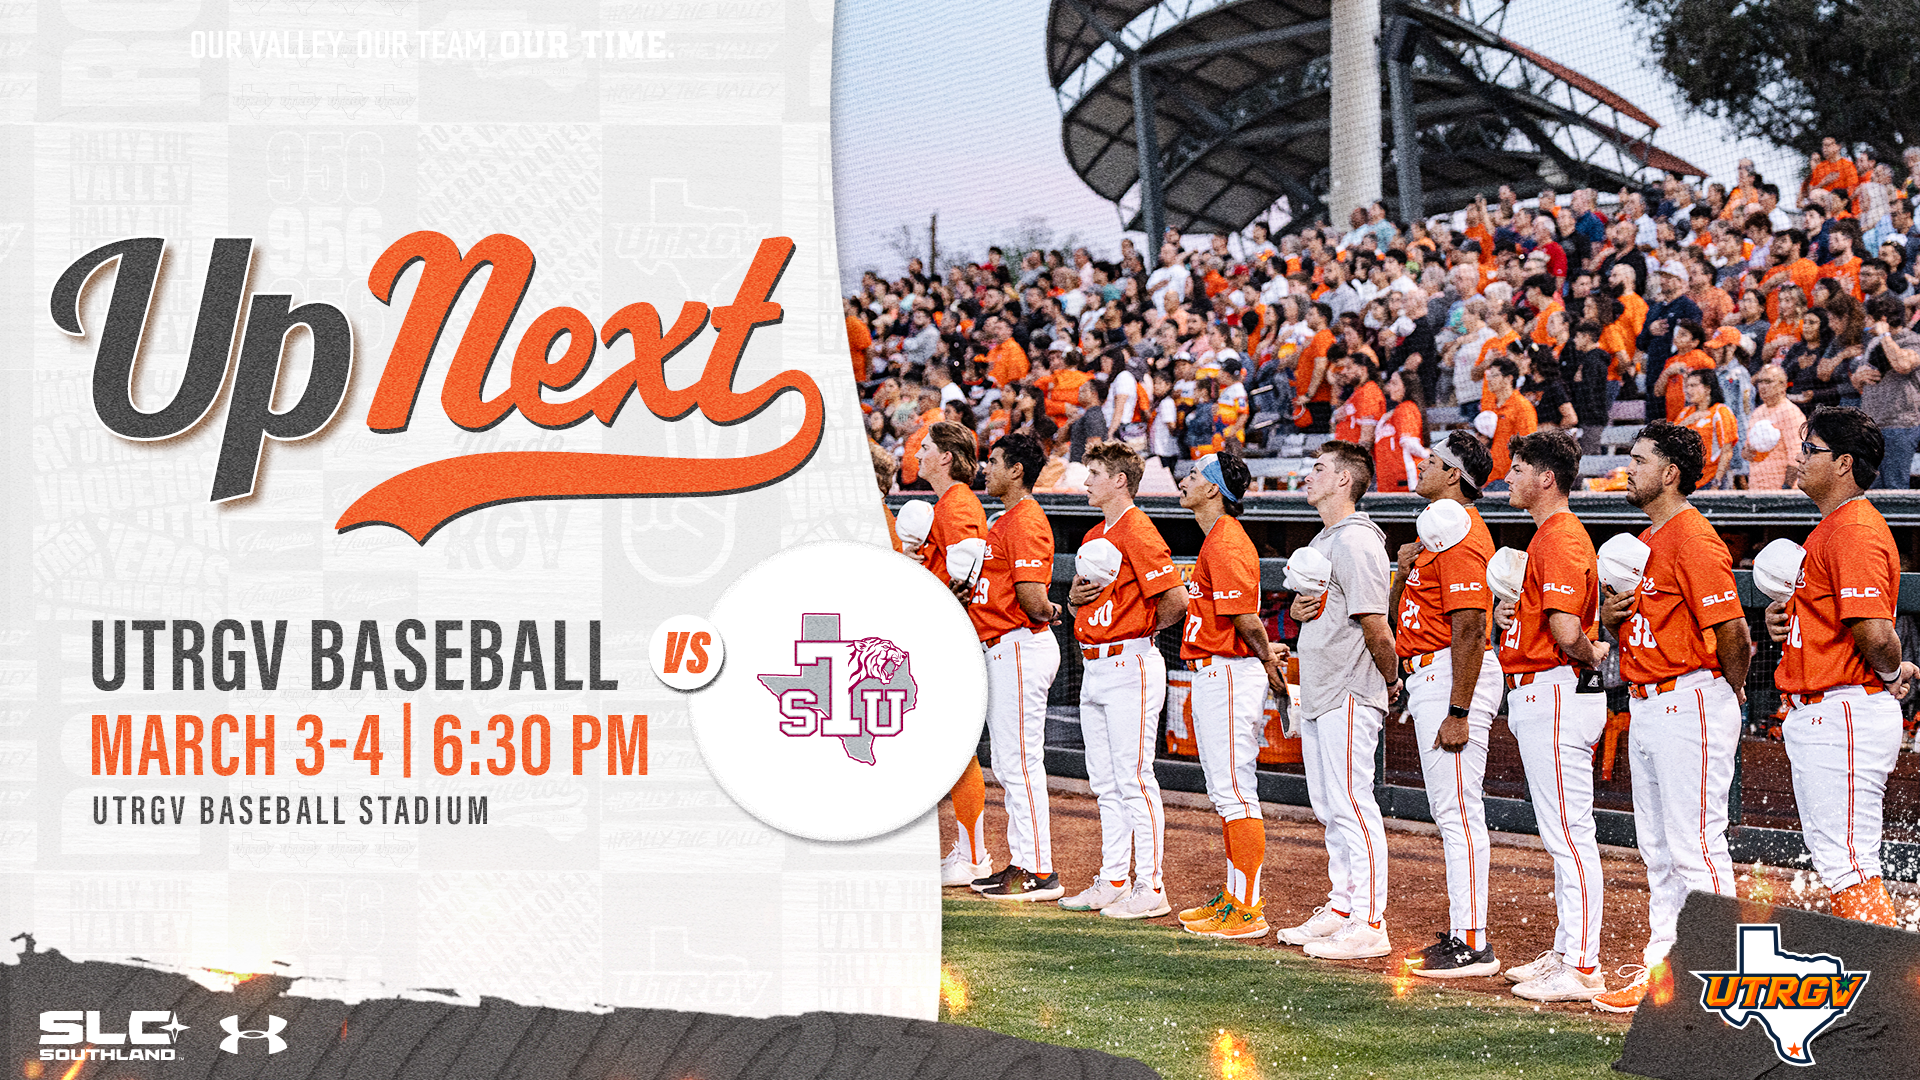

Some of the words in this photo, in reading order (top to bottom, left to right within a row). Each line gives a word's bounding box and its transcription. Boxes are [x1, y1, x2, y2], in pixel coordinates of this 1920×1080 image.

[1015, 559, 1043, 568] SLC
[1145, 565, 1174, 581] SLC
[1450, 582, 1483, 593] SLC
[1542, 582, 1575, 595] SLC
[1840, 587, 1881, 598] SLC
[1213, 590, 1242, 600] SLC
[1702, 590, 1737, 607] SLC
